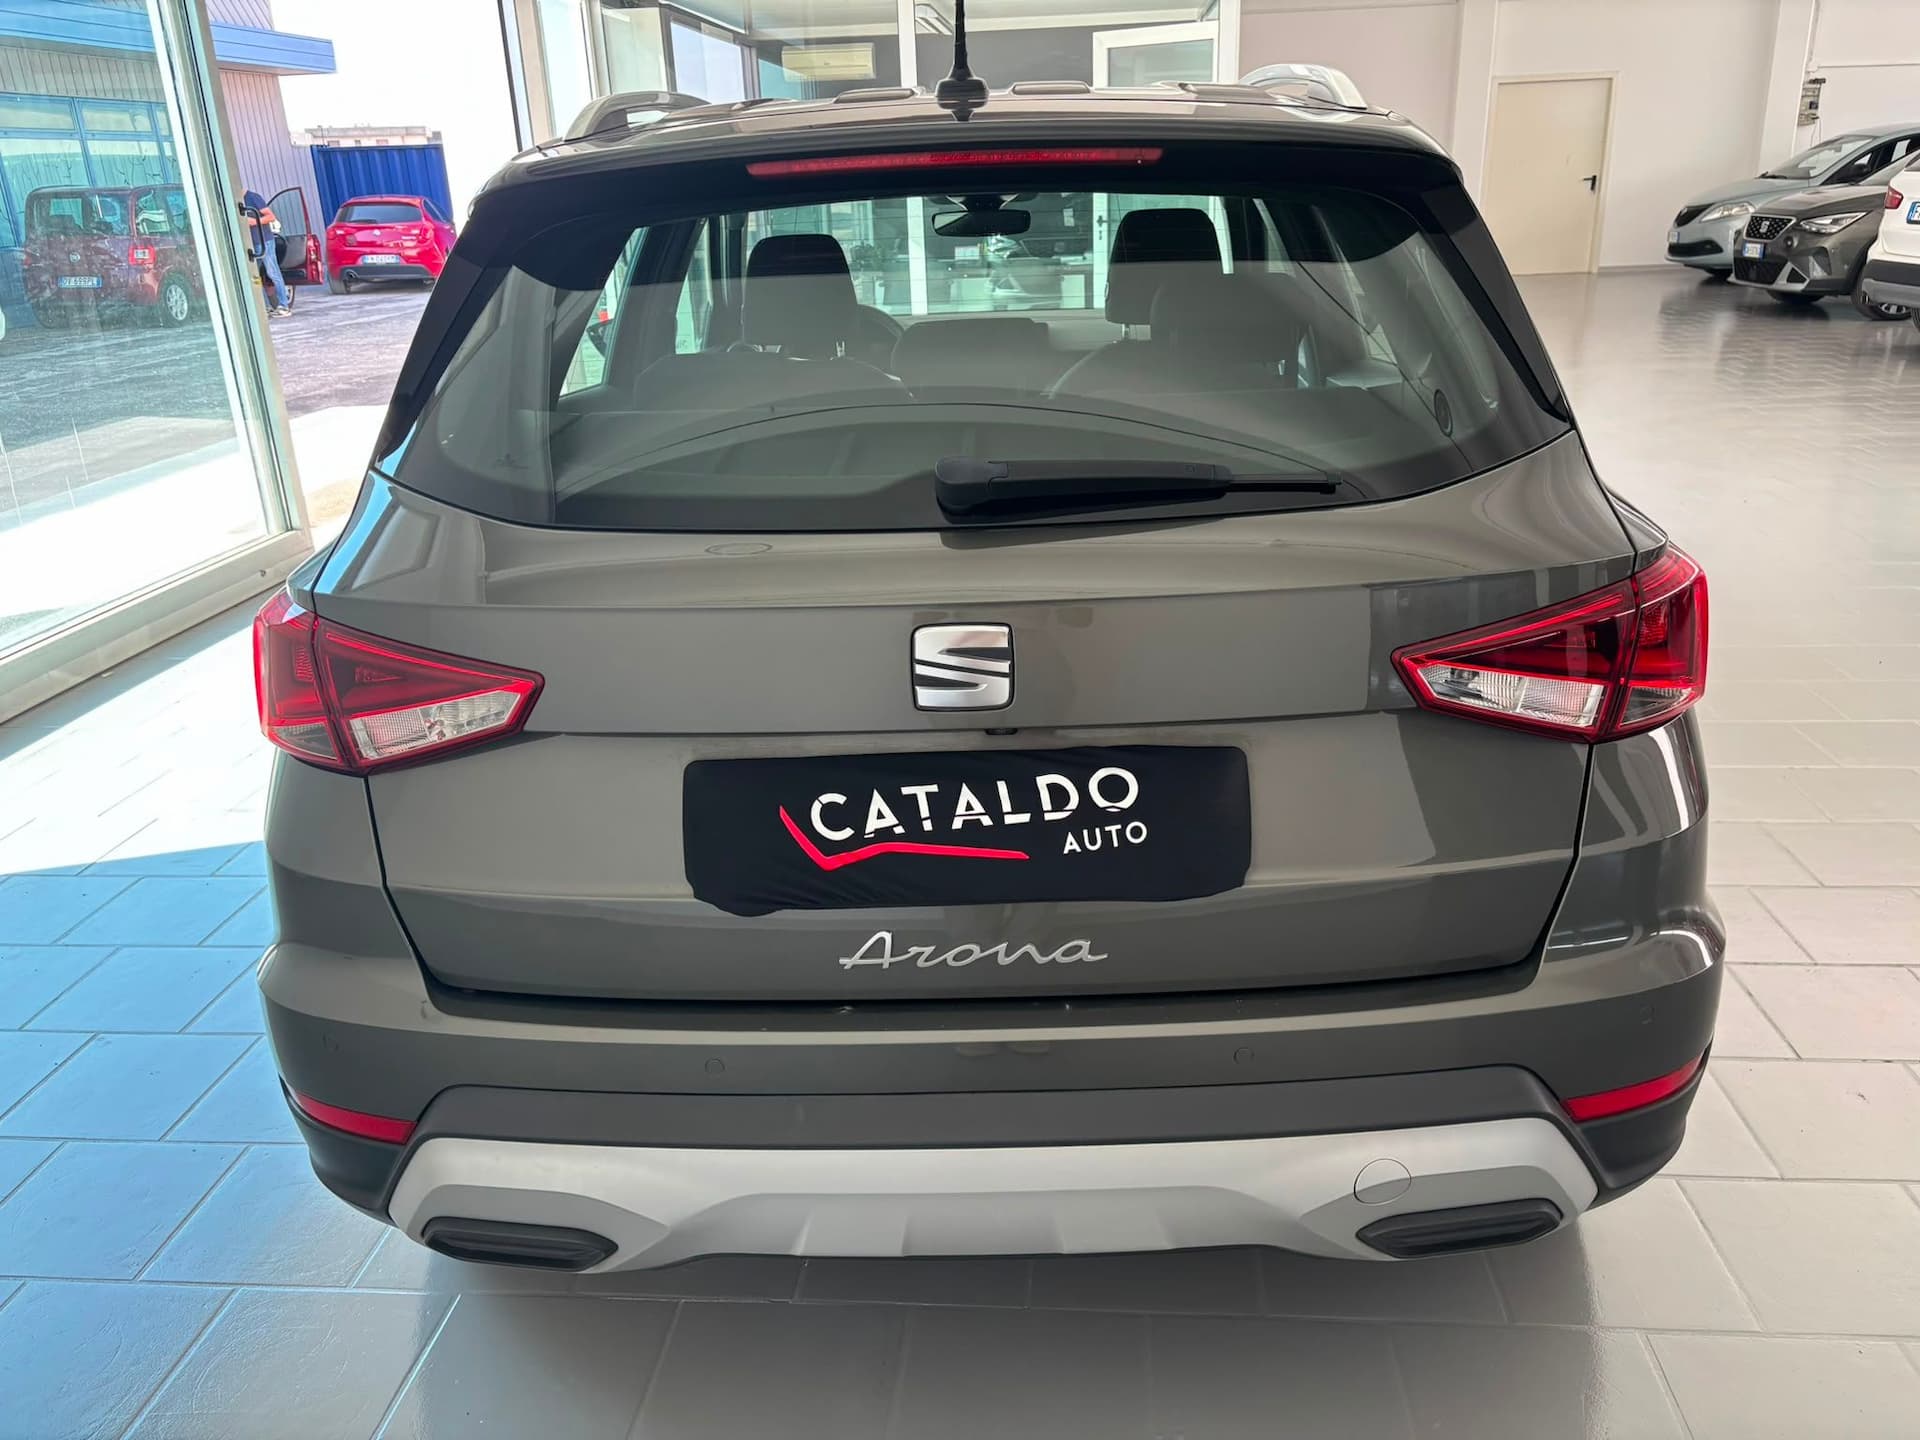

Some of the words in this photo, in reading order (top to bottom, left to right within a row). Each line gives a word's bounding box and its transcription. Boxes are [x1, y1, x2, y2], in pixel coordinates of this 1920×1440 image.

[810, 766, 1140, 841] CATALDO
[1063, 821, 1149, 854] AUTO
[838, 930, 1109, 970] Arona
